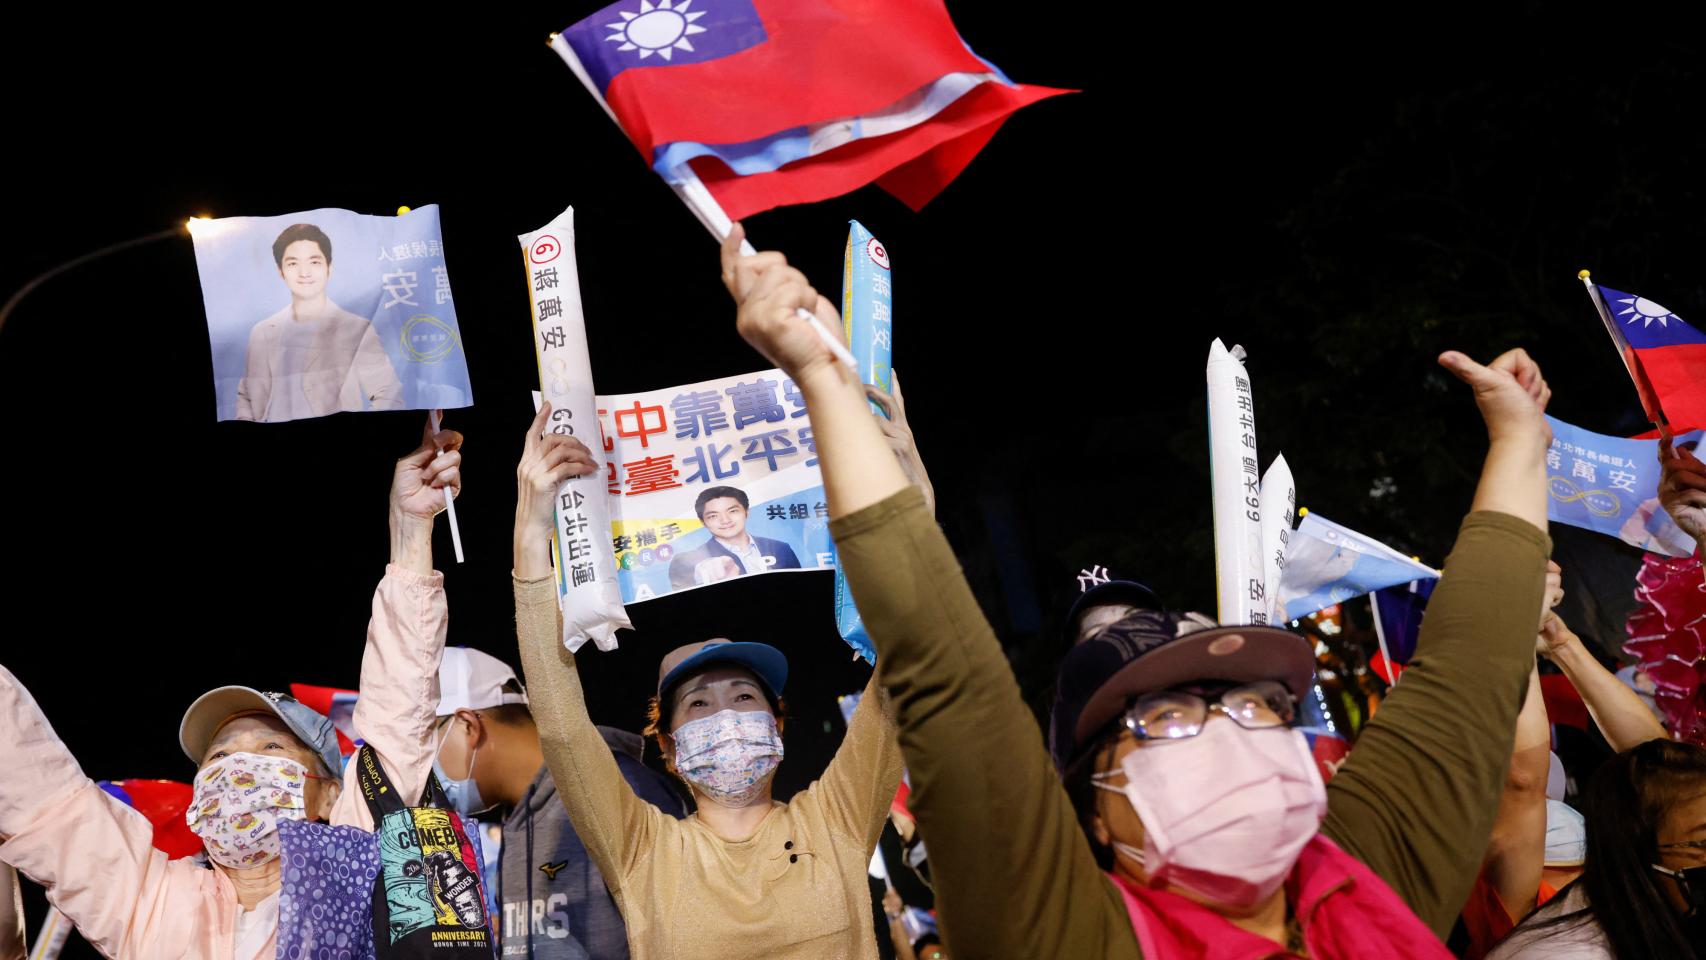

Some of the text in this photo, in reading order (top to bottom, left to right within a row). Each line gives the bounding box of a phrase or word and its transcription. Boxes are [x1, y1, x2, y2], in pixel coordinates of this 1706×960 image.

[533, 266, 566, 351] 蔣萬安
[560, 490, 596, 587] 台北出運
[1243, 455, 1261, 523] 66大順
[444, 876, 474, 900] WONDER
[431, 931, 485, 941] ANNIVERSARY
